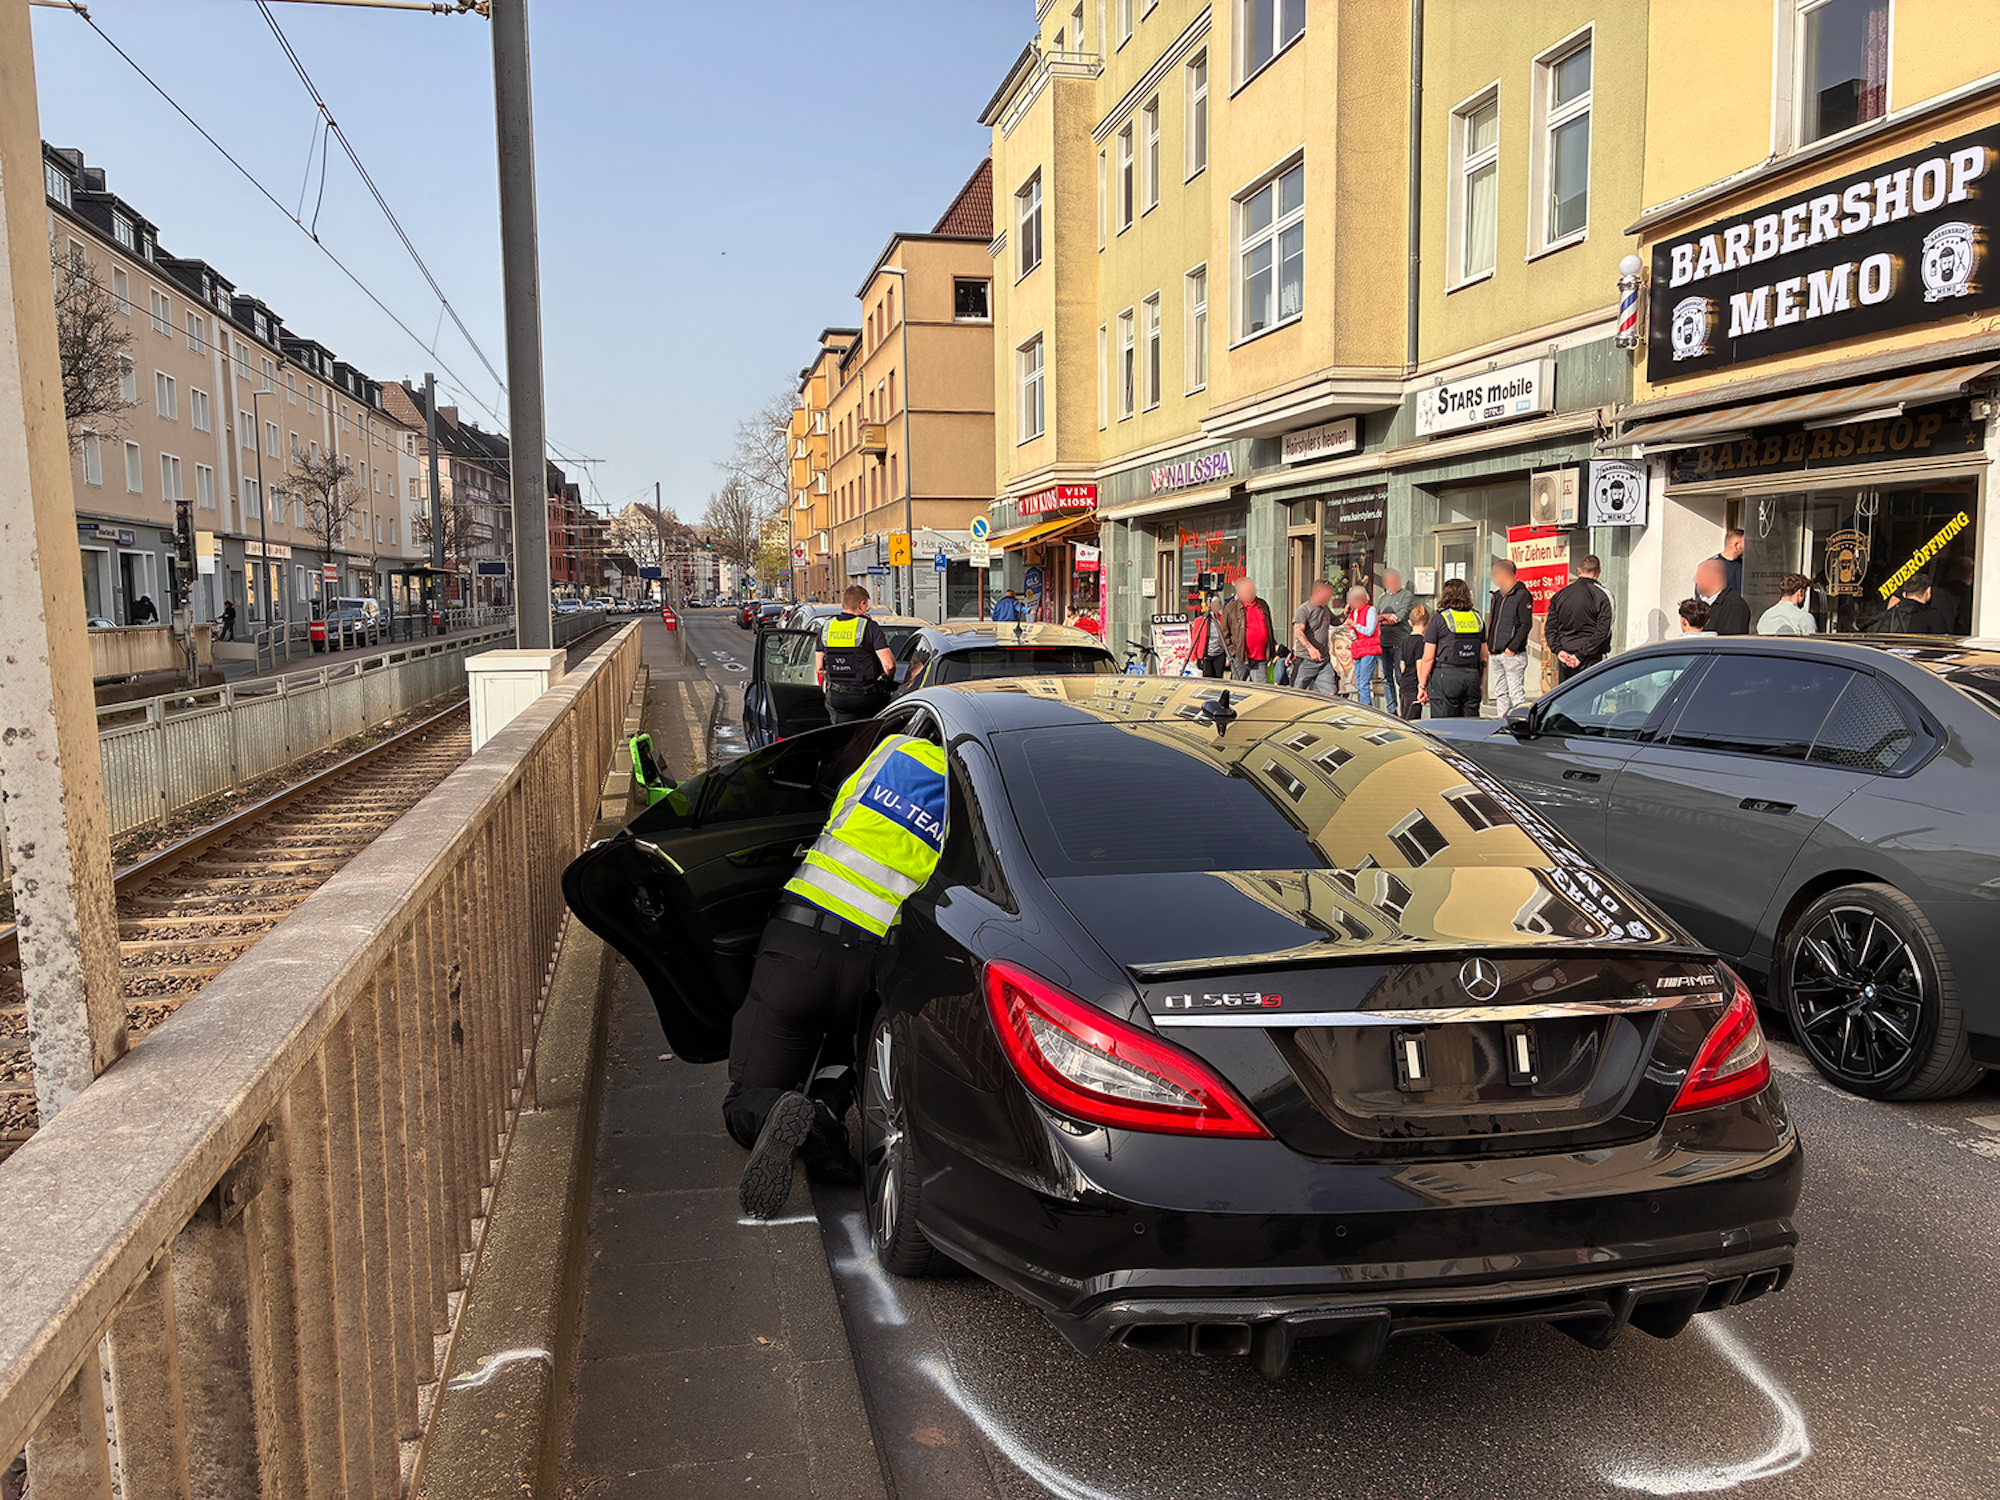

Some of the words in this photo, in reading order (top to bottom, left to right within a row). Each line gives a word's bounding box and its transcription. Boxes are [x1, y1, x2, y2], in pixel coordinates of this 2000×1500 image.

[1669, 145, 1986, 289] BARBERSHOP
[1728, 251, 1893, 339] MEMO
[1438, 387, 1482, 415] STARS
[1488, 377, 1533, 403] mobile
[1694, 413, 1943, 475] BARBERSHOP
[1060, 498, 1094, 507] KIOSK
[1065, 487, 1088, 496] VIN
[1525, 544, 1551, 561] Ziehen
[1878, 511, 1970, 601] NEUERÖFFNUNG
[830, 630, 853, 640] POLIZEI
[873, 784, 902, 809] VU-
